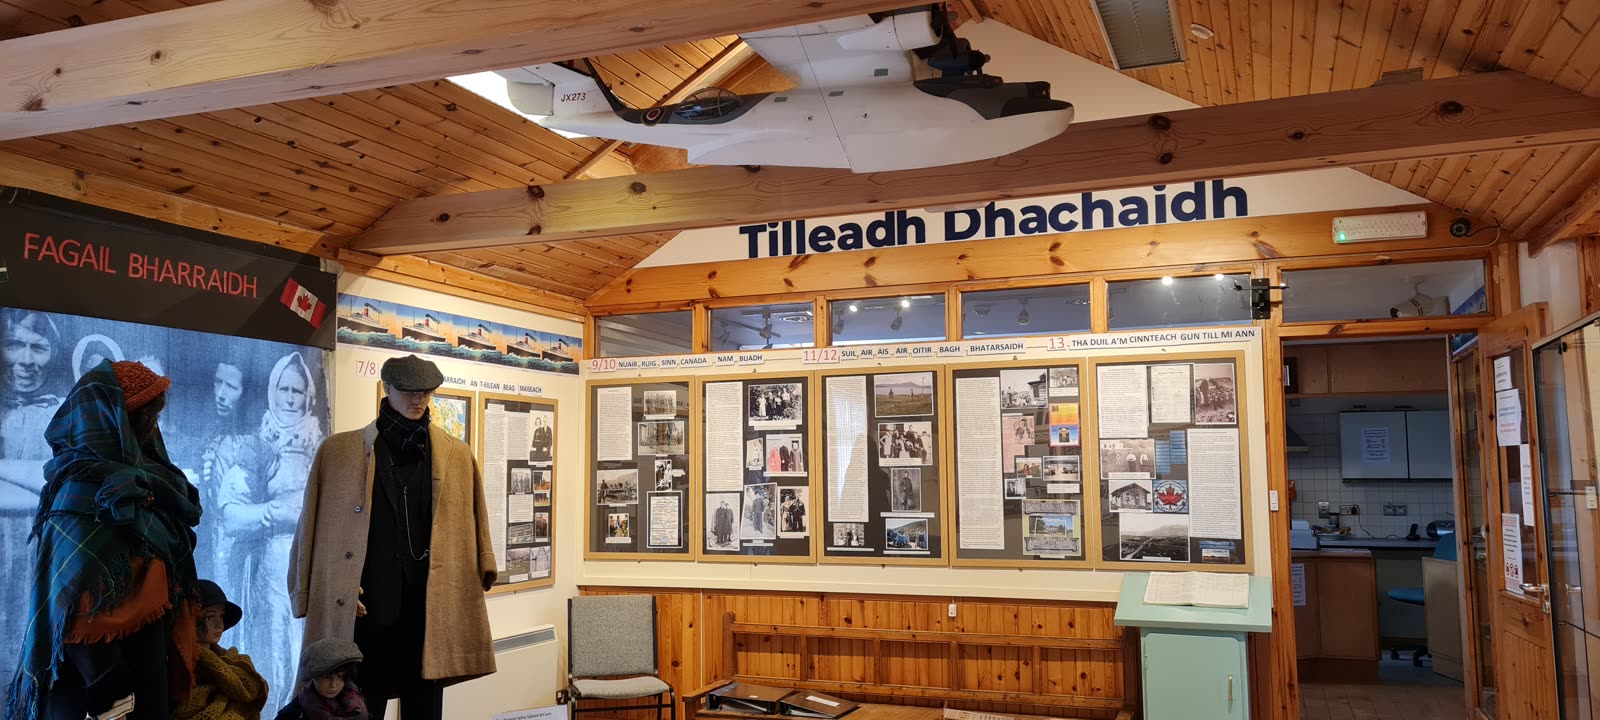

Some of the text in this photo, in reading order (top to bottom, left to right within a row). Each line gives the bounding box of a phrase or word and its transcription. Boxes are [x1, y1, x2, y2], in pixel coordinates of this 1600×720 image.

[561, 92, 586, 102] JX273
[739, 179, 1248, 259] Tilleadh Dhachaidh
[23, 232, 257, 299] FAGAIL BHARRAIDH
[1072, 339, 1089, 347] THA
[1129, 334, 1177, 343] CINNTEACH
[1180, 332, 1200, 340] GUN
[1202, 331, 1219, 339] TILL
[1234, 330, 1255, 338] ANN
[804, 349, 837, 362] 11/12
[970, 342, 1024, 352] BHATARSAIDH
[358, 360, 376, 376] 7/8
[592, 358, 616, 370] 9/10
[480, 382, 500, 390] T-EILEAN
[520, 385, 542, 393] MAISEACH
